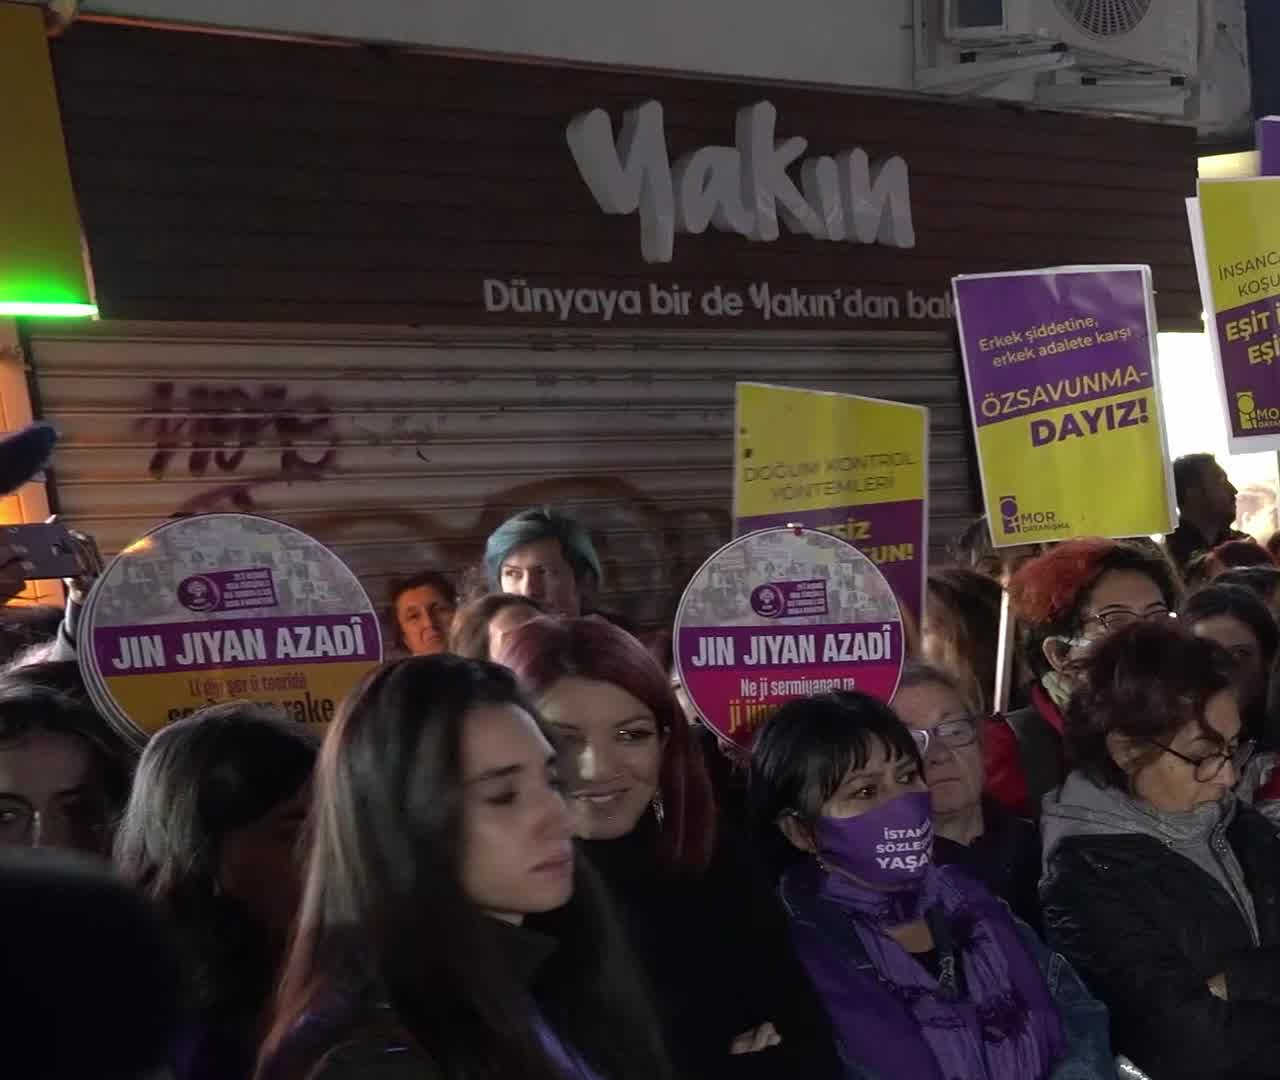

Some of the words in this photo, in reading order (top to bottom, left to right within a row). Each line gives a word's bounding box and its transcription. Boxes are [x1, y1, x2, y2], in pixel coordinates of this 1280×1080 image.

[483, 278, 642, 320] Dünyaya
[650, 283, 691, 316] bir
[701, 284, 744, 317] de
[979, 329, 1023, 352] Erkek
[1026, 315, 1098, 343] şiddetine,
[992, 350, 1035, 368] erkek
[1039, 335, 1093, 357] adalete
[1096, 326, 1132, 345] karşı
[1225, 308, 1270, 344] EŞİT
[981, 364, 1149, 418] ÖZSAVUNMA-
[1030, 397, 1149, 448] DAYIZ!
[1020, 511, 1056, 525] MOR
[112, 635, 168, 671] JIN
[175, 627, 268, 666] JIYAN
[276, 616, 367, 658] AZADÎ
[691, 636, 735, 667] JIN
[743, 633, 816, 665] JIYAN
[822, 624, 891, 663] AZADÎ
[740, 678, 758, 697] Ne
[758, 677, 769, 702] ji
